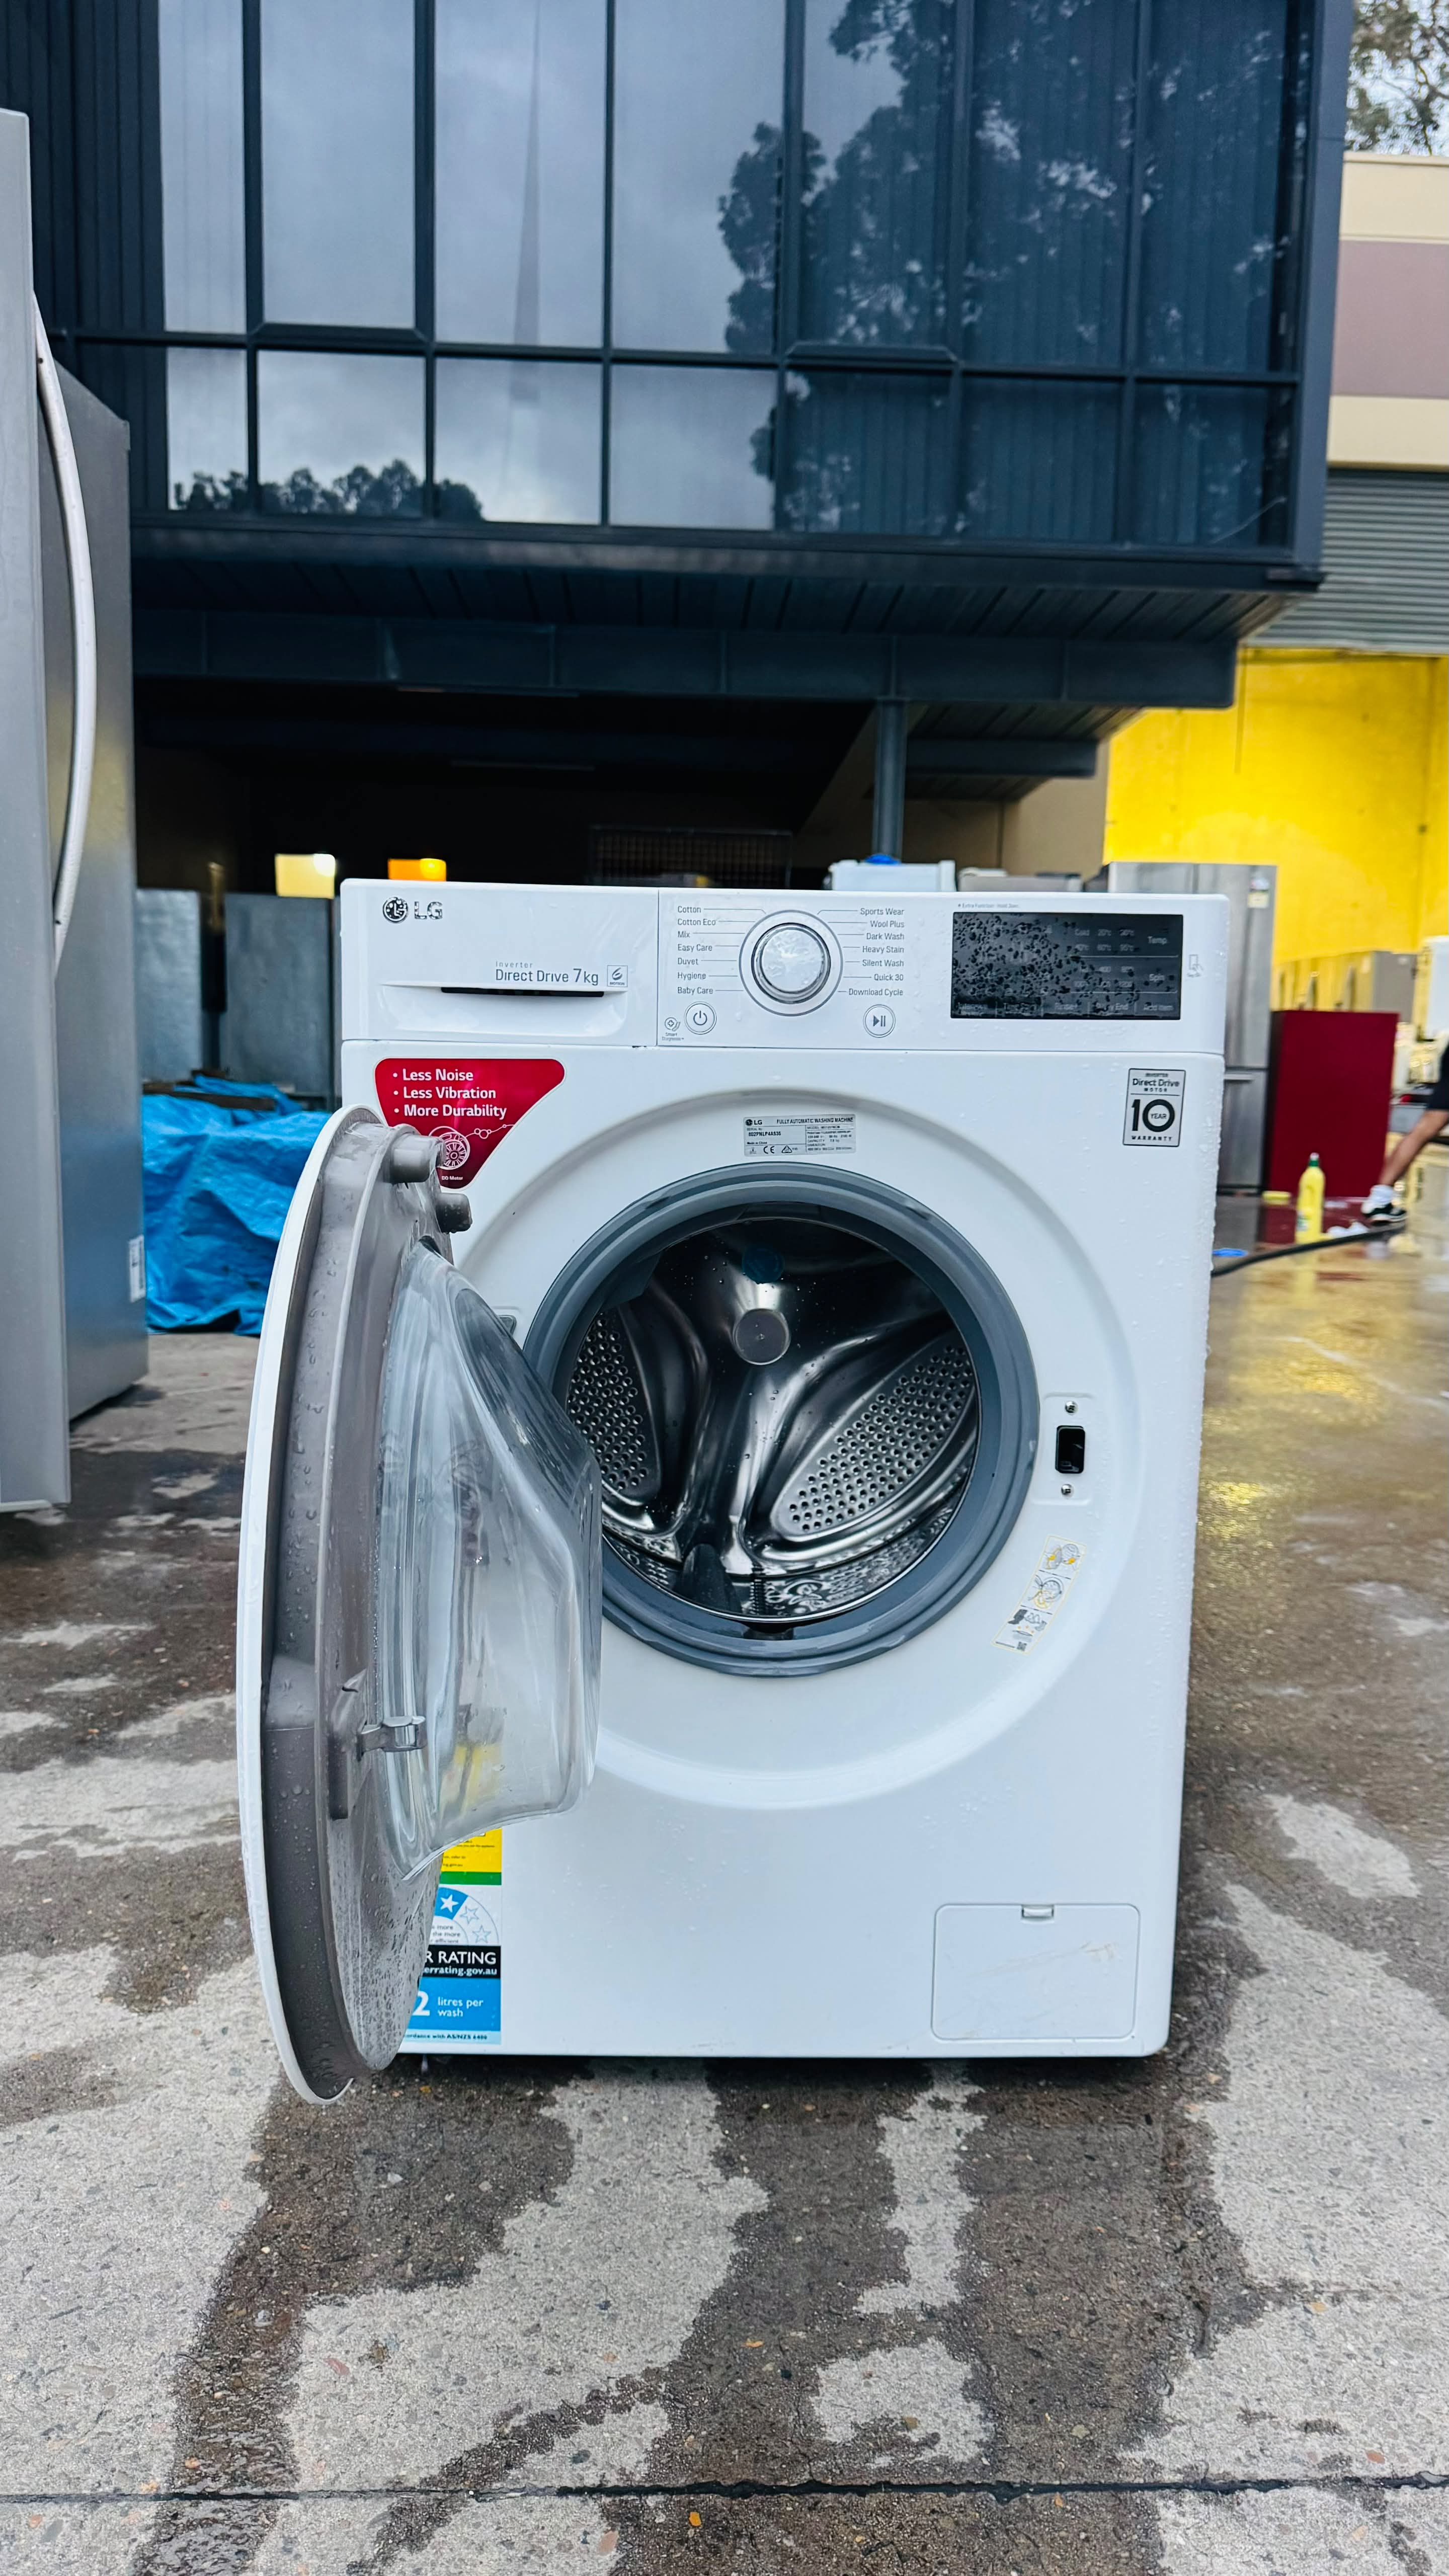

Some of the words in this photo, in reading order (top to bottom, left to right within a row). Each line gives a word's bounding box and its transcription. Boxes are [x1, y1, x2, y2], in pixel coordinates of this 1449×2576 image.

[414, 901, 443, 920] LG
[860, 908, 884, 916] Sports
[677, 944, 694, 952] Easy
[862, 945, 884, 954] Heavy
[496, 969, 533, 982] Direct
[537, 970, 569, 983] Drive
[677, 972, 706, 981] Hygiene
[677, 987, 695, 995] Baby
[849, 988, 882, 996] Download
[884, 988, 904, 997] Cycle
[403, 1069, 432, 1081] Less
[436, 1069, 473, 1081] Noise
[1132, 1078, 1157, 1086] Direct
[1158, 1079, 1180, 1087] Drive
[403, 1086, 433, 1099] Less
[436, 1087, 496, 1099] Vibration
[404, 1104, 439, 1116] More
[442, 1104, 507, 1120] Durability
[1131, 1099, 1175, 1133] 10
[438, 1951, 497, 1965] RATING
[424, 1965, 497, 1977] errating.gov.au
[412, 1990, 430, 2016] 2
[437, 1996, 463, 2006] litres
[466, 1999, 484, 2009] per
[437, 2007, 464, 2017] wash
